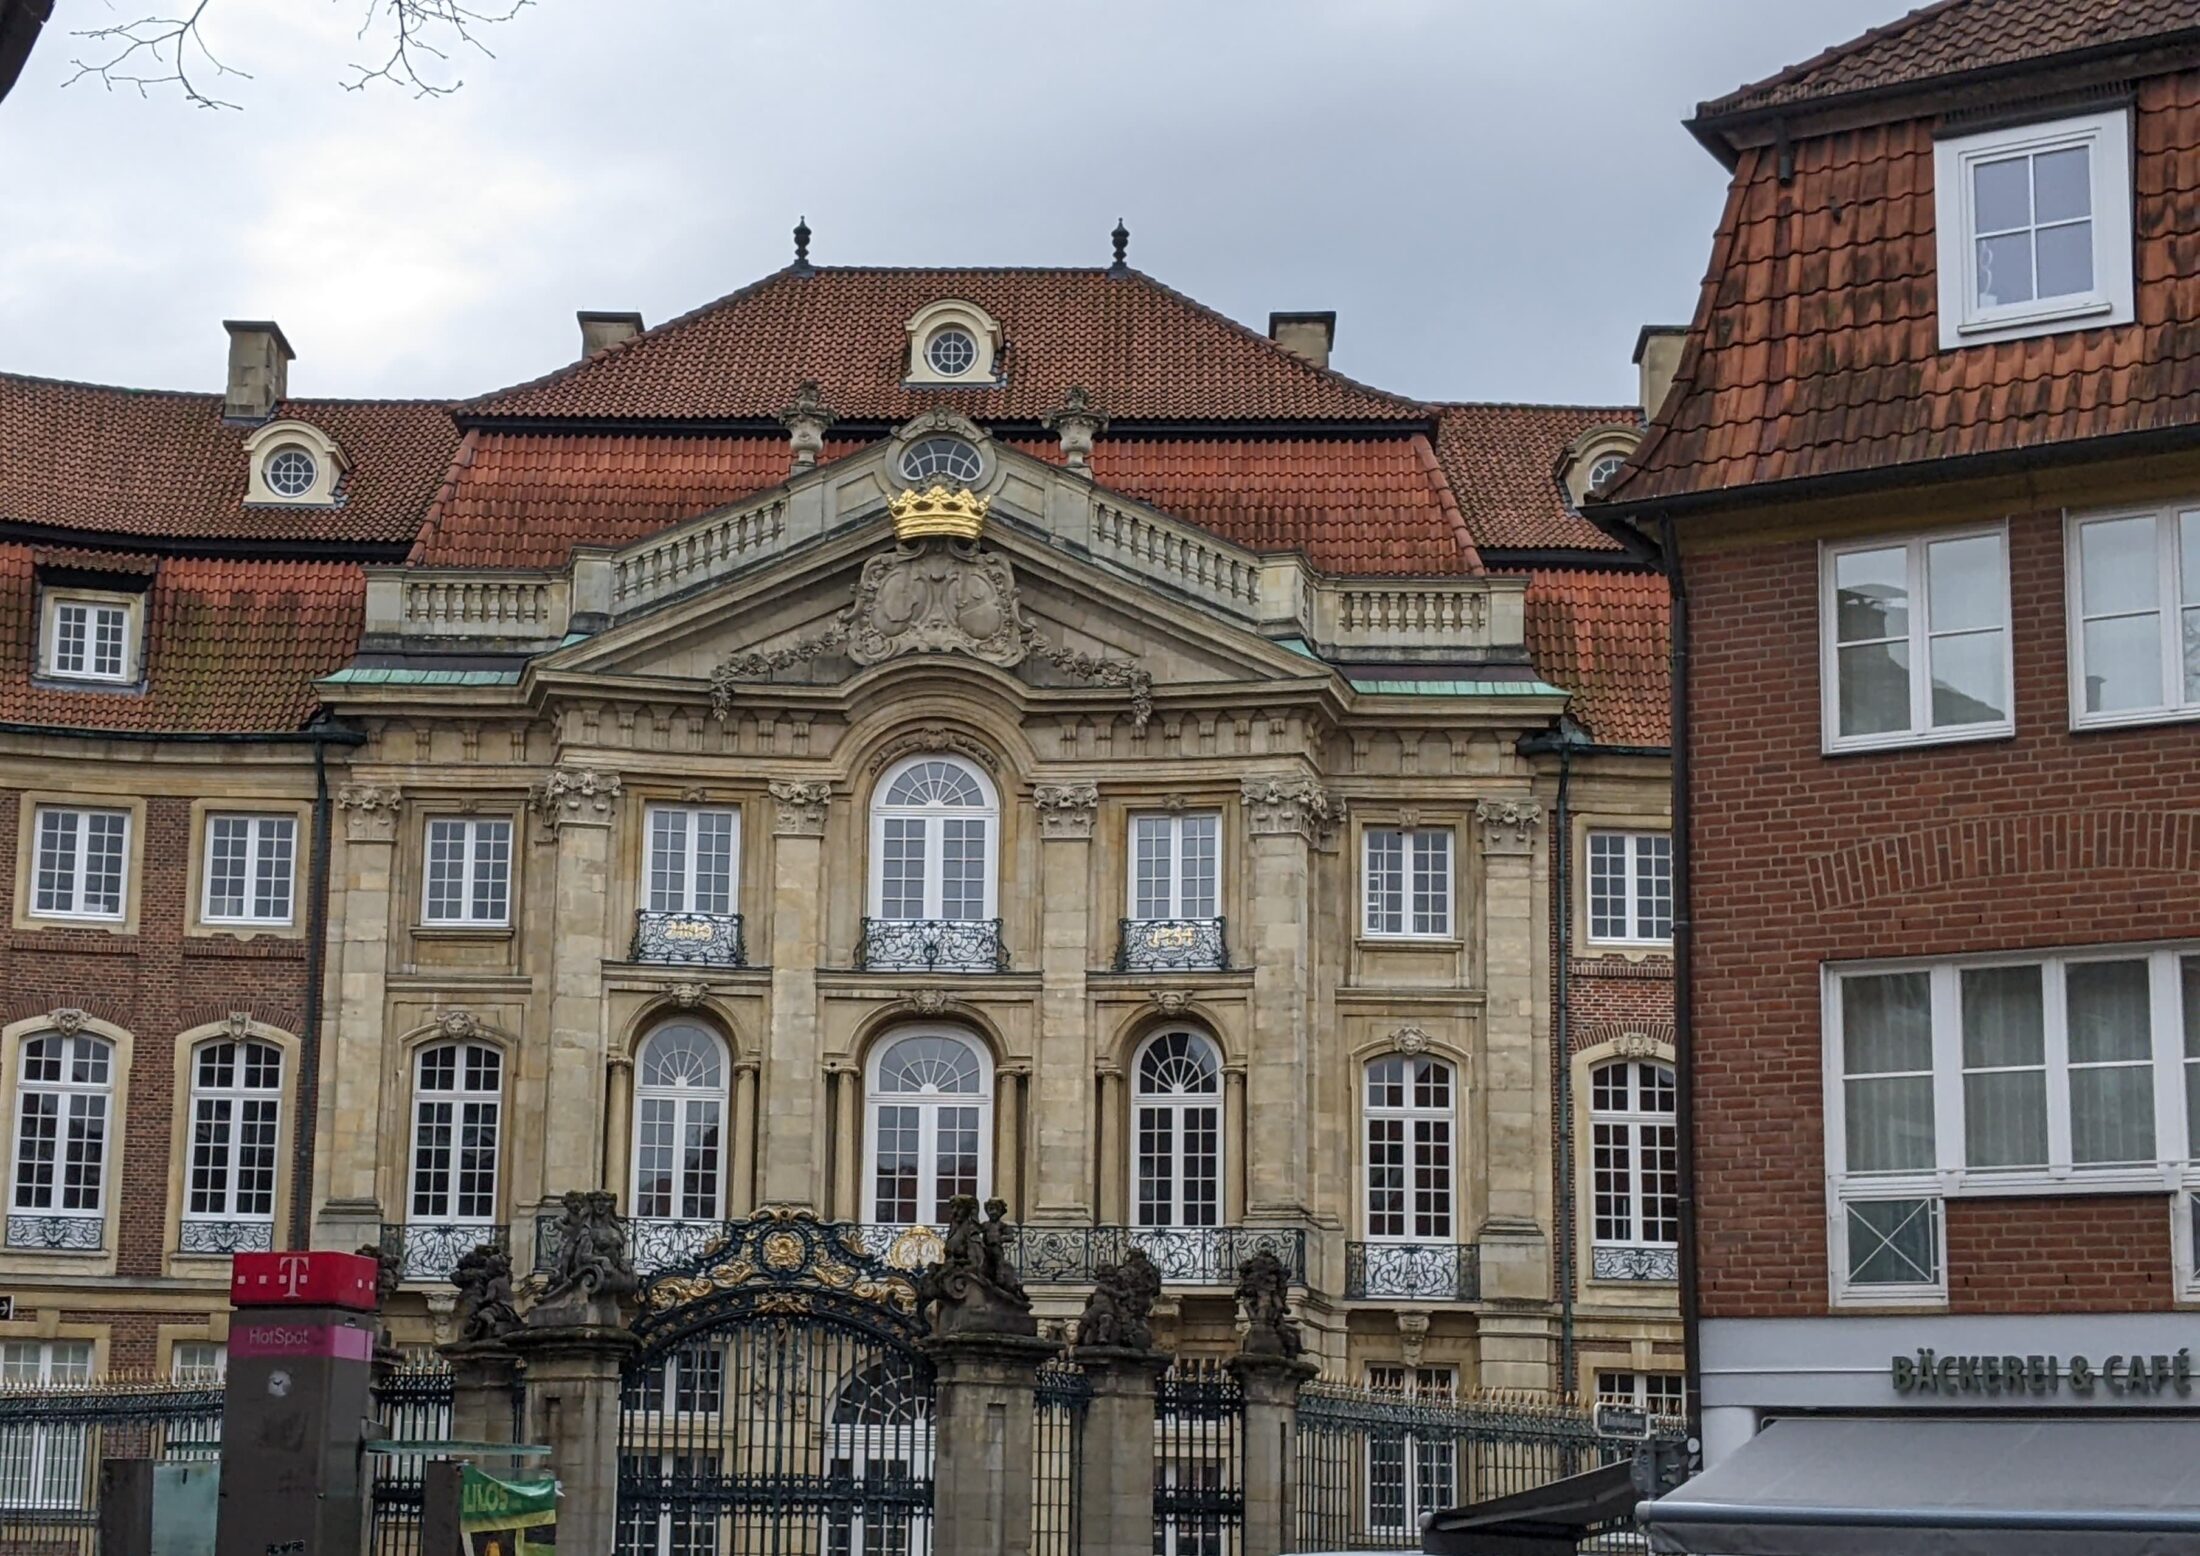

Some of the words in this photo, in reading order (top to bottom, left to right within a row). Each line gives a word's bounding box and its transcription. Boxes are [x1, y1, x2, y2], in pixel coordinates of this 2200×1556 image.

[249, 1326, 308, 1346] HotSpot
[1892, 1348, 2058, 1394] BÄCKEREI
[2067, 1355, 2095, 1394] &
[2103, 1347, 2192, 1395] CAFÉ
